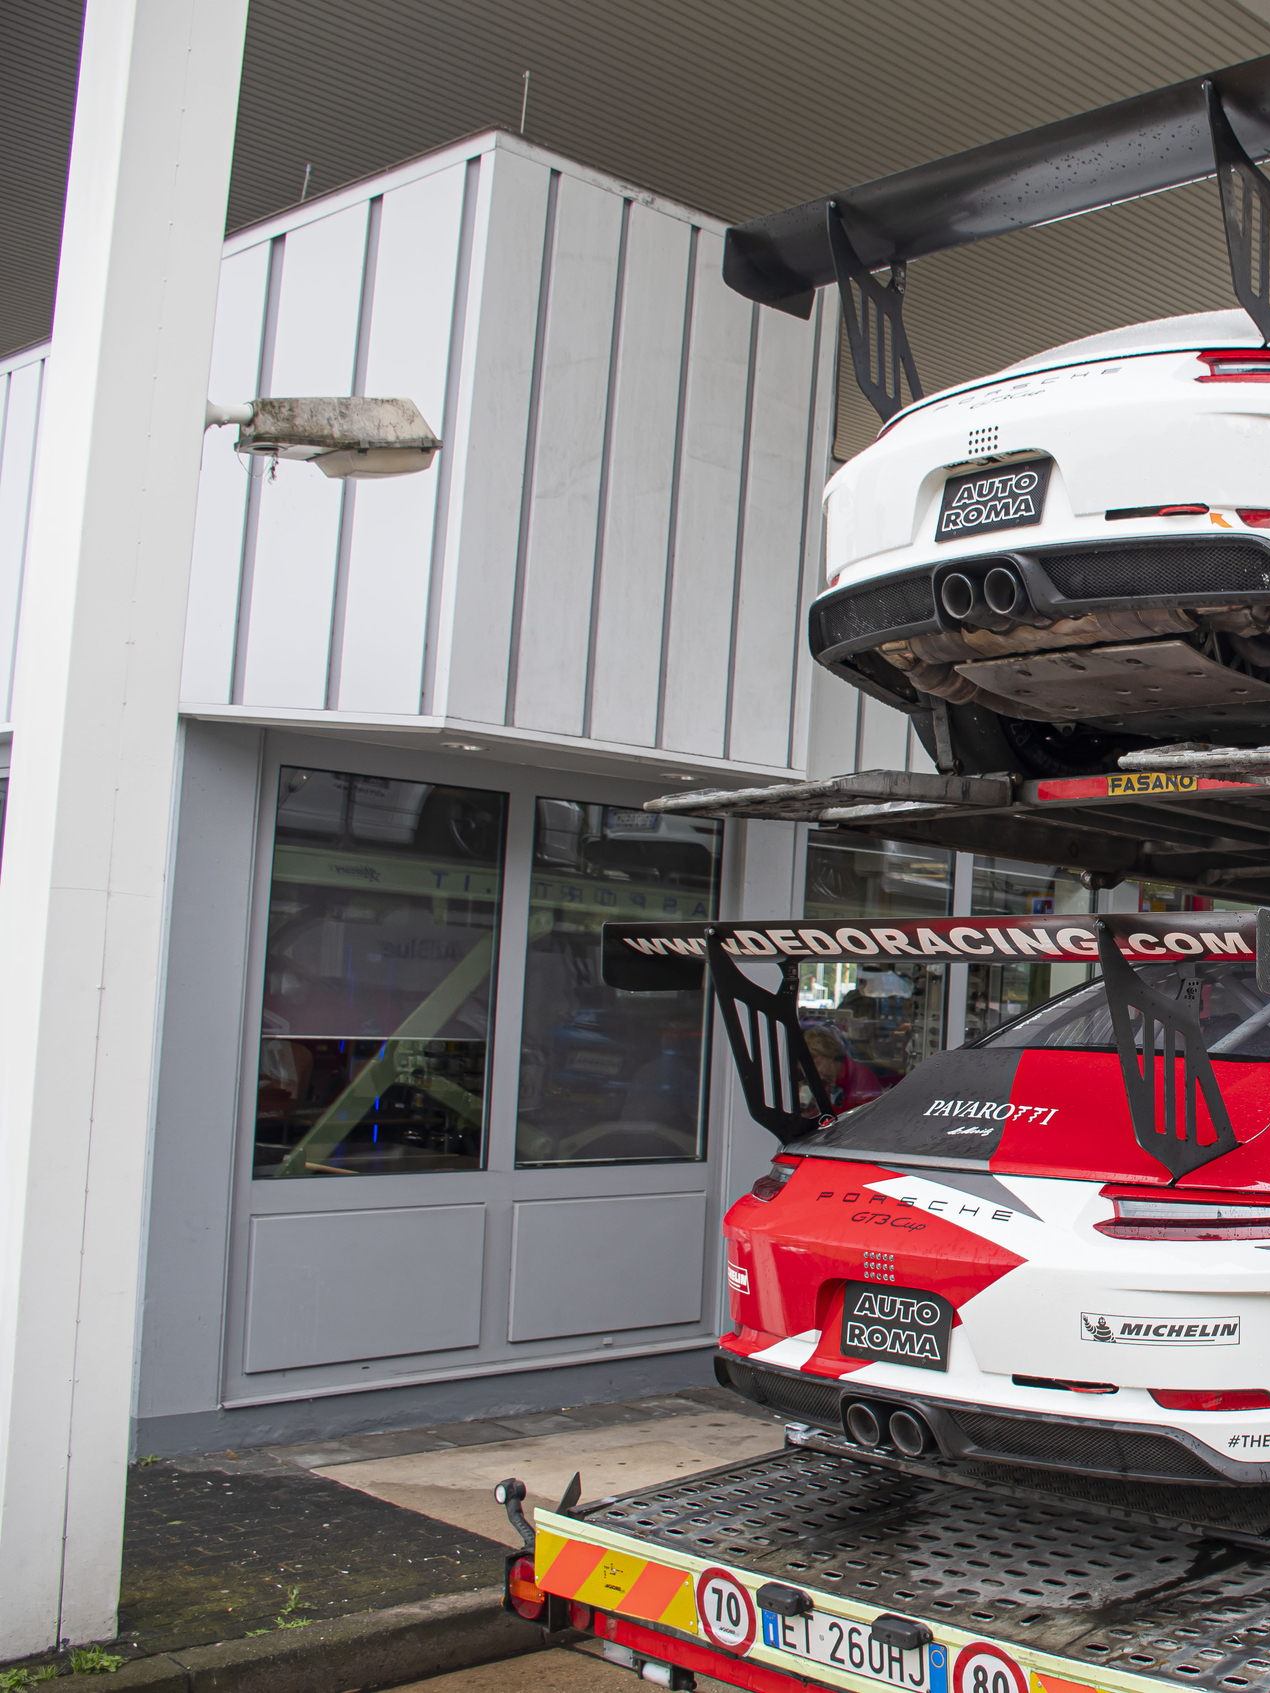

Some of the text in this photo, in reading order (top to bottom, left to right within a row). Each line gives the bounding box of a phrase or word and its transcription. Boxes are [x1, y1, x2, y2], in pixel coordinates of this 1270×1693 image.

[952, 471, 1039, 507] AUTO
[941, 495, 1035, 532] ROMA
[1110, 774, 1194, 794] FASANO
[623, 927, 1254, 956] WWW.DEDORACING.COM
[923, 1100, 1059, 1126] PAVAROTTI
[816, 1191, 1013, 1222] PORSCHE
[851, 1211, 926, 1233] GT3 Cup
[854, 1292, 940, 1326] AUTO
[846, 1321, 941, 1360] ROMA
[1120, 1322, 1238, 1338] MICHELIN
[711, 1586, 741, 1628] 70
[782, 1609, 813, 1654] ET
[829, 1621, 924, 1687] 260HJ
[973, 1665, 1011, 1693] 80
